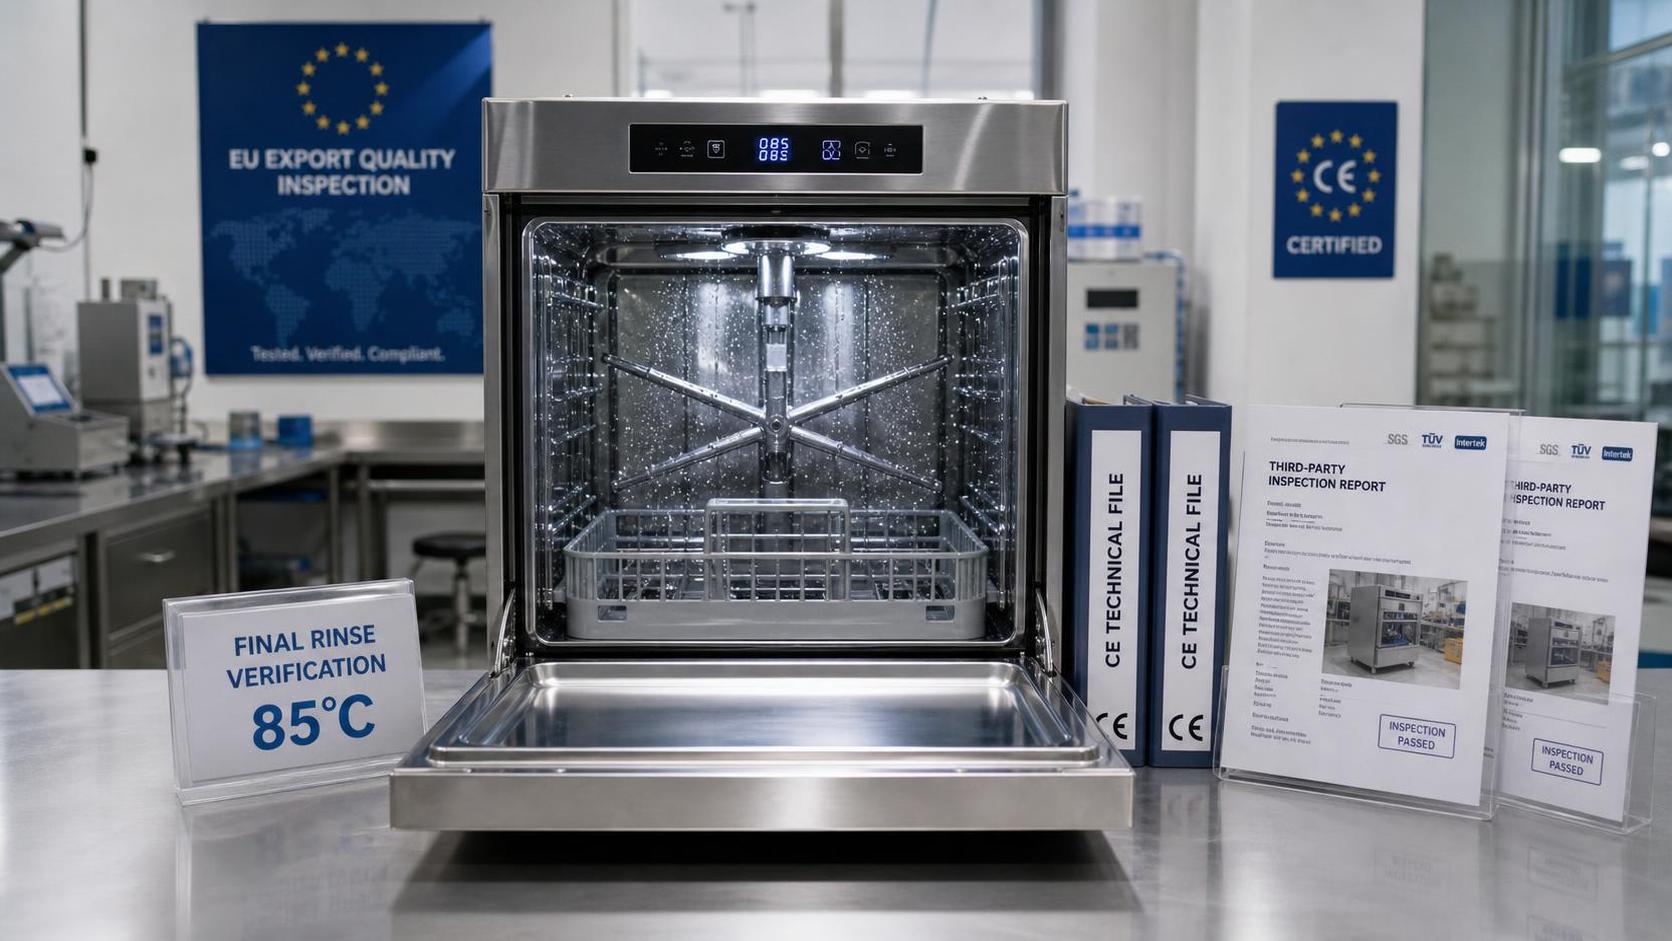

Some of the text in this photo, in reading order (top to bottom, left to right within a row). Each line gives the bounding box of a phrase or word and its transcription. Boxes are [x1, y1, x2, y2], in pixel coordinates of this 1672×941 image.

[229, 149, 456, 172] EU EXPORT QUALITY
[278, 174, 411, 196] INSPECTION
[1313, 160, 1357, 194] CE
[1286, 235, 1383, 255] CERTIFIED
[251, 346, 446, 364] Tested. Verified. Compliant.
[1387, 433, 1409, 446] SGS
[1456, 438, 1486, 448] Intertek
[1539, 444, 1559, 456] SGS
[1269, 460, 1346, 475] THIRD-PARTY
[1268, 475, 1386, 493] INSPECTION REPORT
[1565, 497, 1606, 511] REPORT
[1105, 473, 1123, 668] CE TECHNICAL FILE
[1181, 474, 1202, 669] CE TECHNICAL FILE
[234, 624, 376, 657] FINAL RINSE
[226, 653, 386, 689] VERIFICATION
[252, 693, 376, 751] 85°C
[1169, 714, 1204, 742] CE
[1389, 721, 1446, 738] INSPECTION
[1397, 736, 1435, 751] PASSED
[1541, 745, 1594, 764] INSPECTION
[1549, 760, 1584, 776] PASSED
